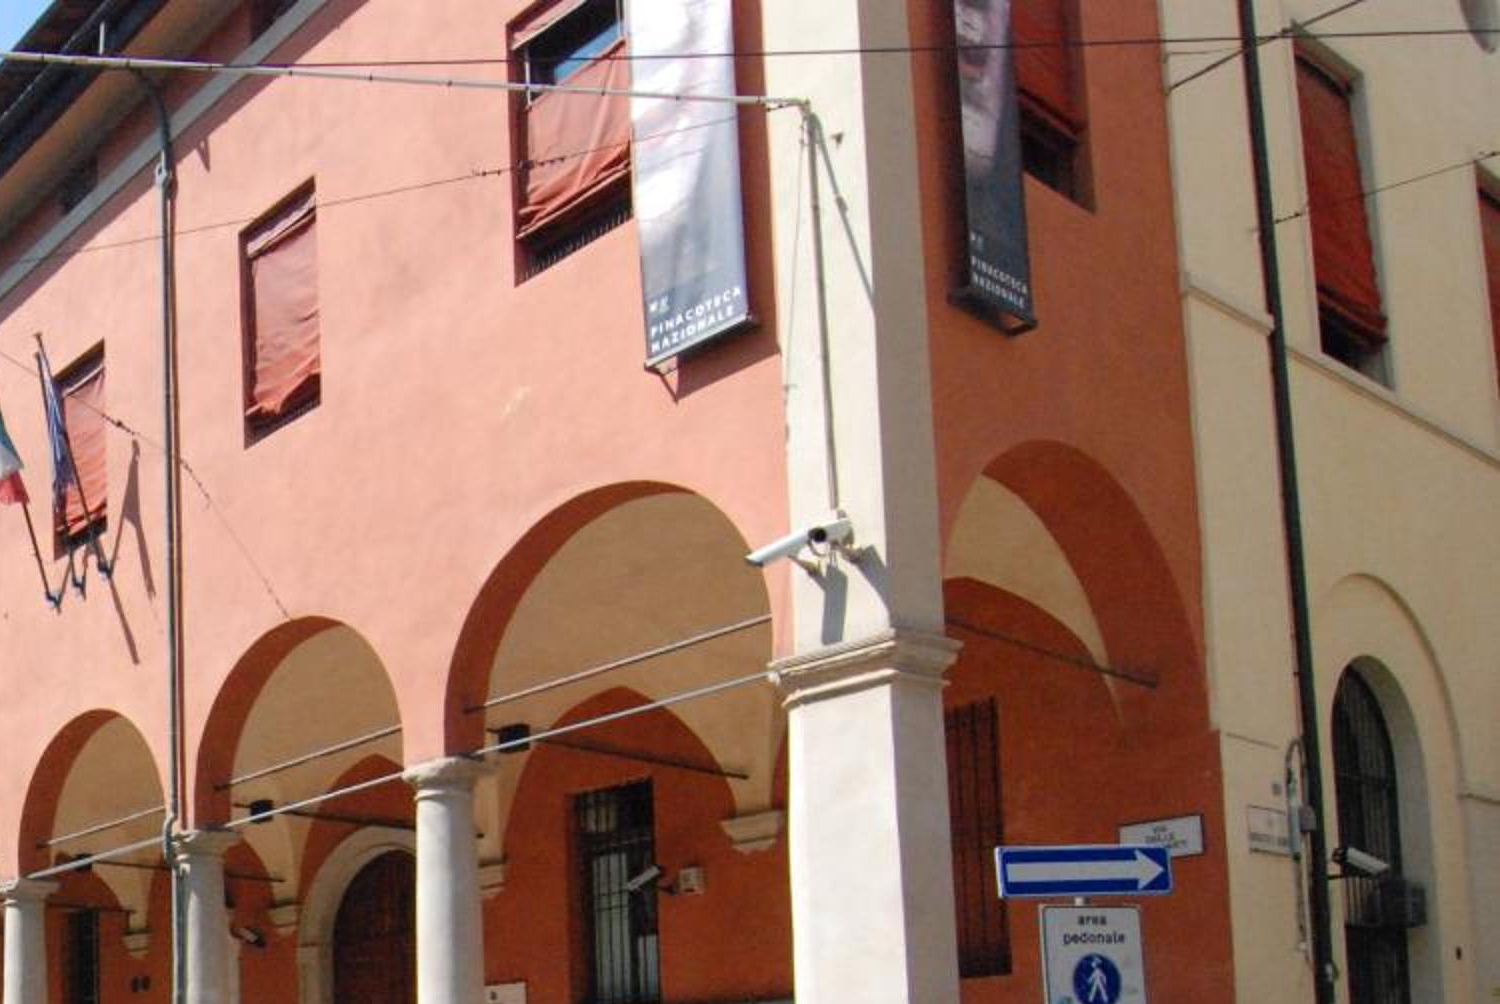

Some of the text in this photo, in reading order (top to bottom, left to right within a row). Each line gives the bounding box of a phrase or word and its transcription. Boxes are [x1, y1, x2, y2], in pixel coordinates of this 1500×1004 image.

[651, 286, 741, 338] PINACOTECA
[651, 305, 734, 353] NAZIONALE
[1077, 915, 1107, 926] area
[1063, 931, 1125, 946] pedonale
